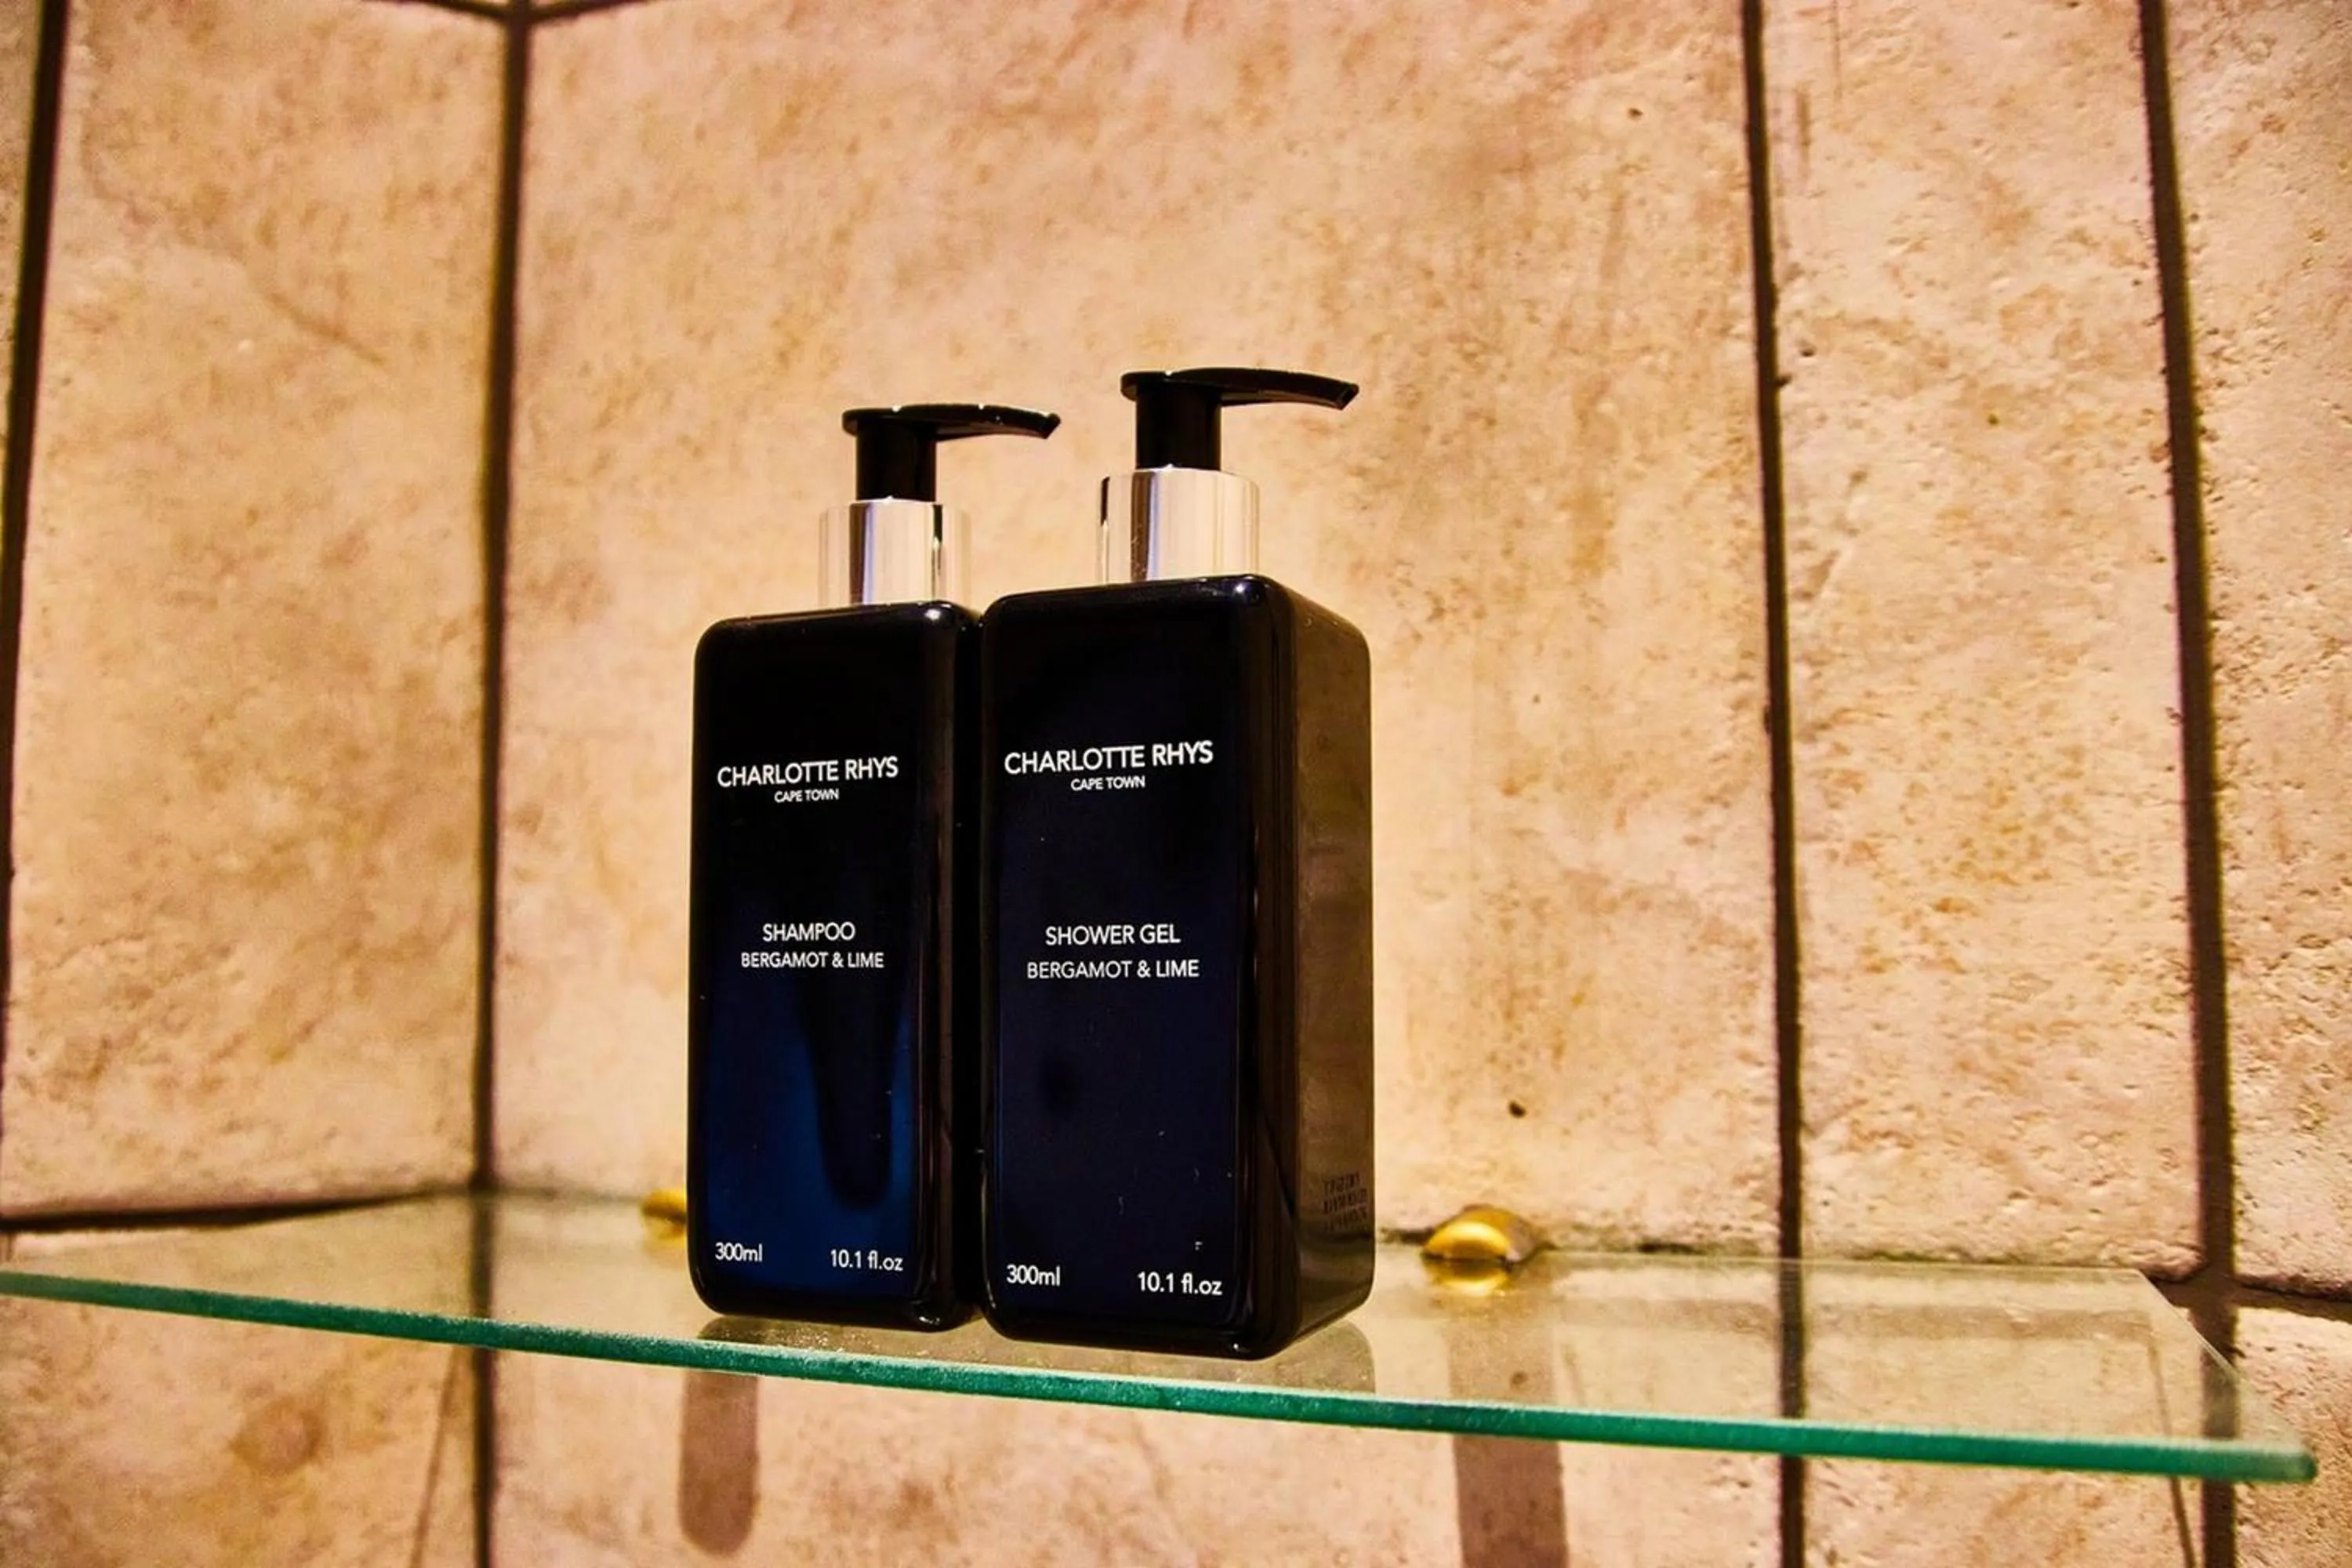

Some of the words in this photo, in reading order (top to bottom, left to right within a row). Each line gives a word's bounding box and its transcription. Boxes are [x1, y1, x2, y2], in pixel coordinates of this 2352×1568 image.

[1004, 745, 1145, 775] CHARLOTTE
[1152, 739, 1214, 767] RHYS
[717, 760, 840, 787] CHARLOTTE
[844, 755, 899, 780] RHYS
[1070, 777, 1104, 791] CAPE
[1105, 775, 1145, 789] TOWN
[774, 789, 803, 804] CAPE
[804, 788, 840, 801] TOWN
[762, 921, 856, 942] SHAMPOO
[1045, 924, 1135, 946] SHOWER
[1139, 924, 1181, 945] GEL
[741, 951, 829, 968] BERGAMOT
[831, 951, 844, 968] &
[848, 952, 884, 968] LIME
[1027, 960, 1133, 979] BERGAMOT
[1136, 959, 1151, 978] &
[1156, 959, 1200, 978] LIME
[715, 1241, 763, 1262] 300ml
[830, 1249, 862, 1269] 10.1
[867, 1250, 904, 1272] fl.oz
[1006, 1264, 1061, 1287] 300ml
[1138, 1271, 1174, 1293] 10.1
[1181, 1272, 1223, 1296] fl.oz
